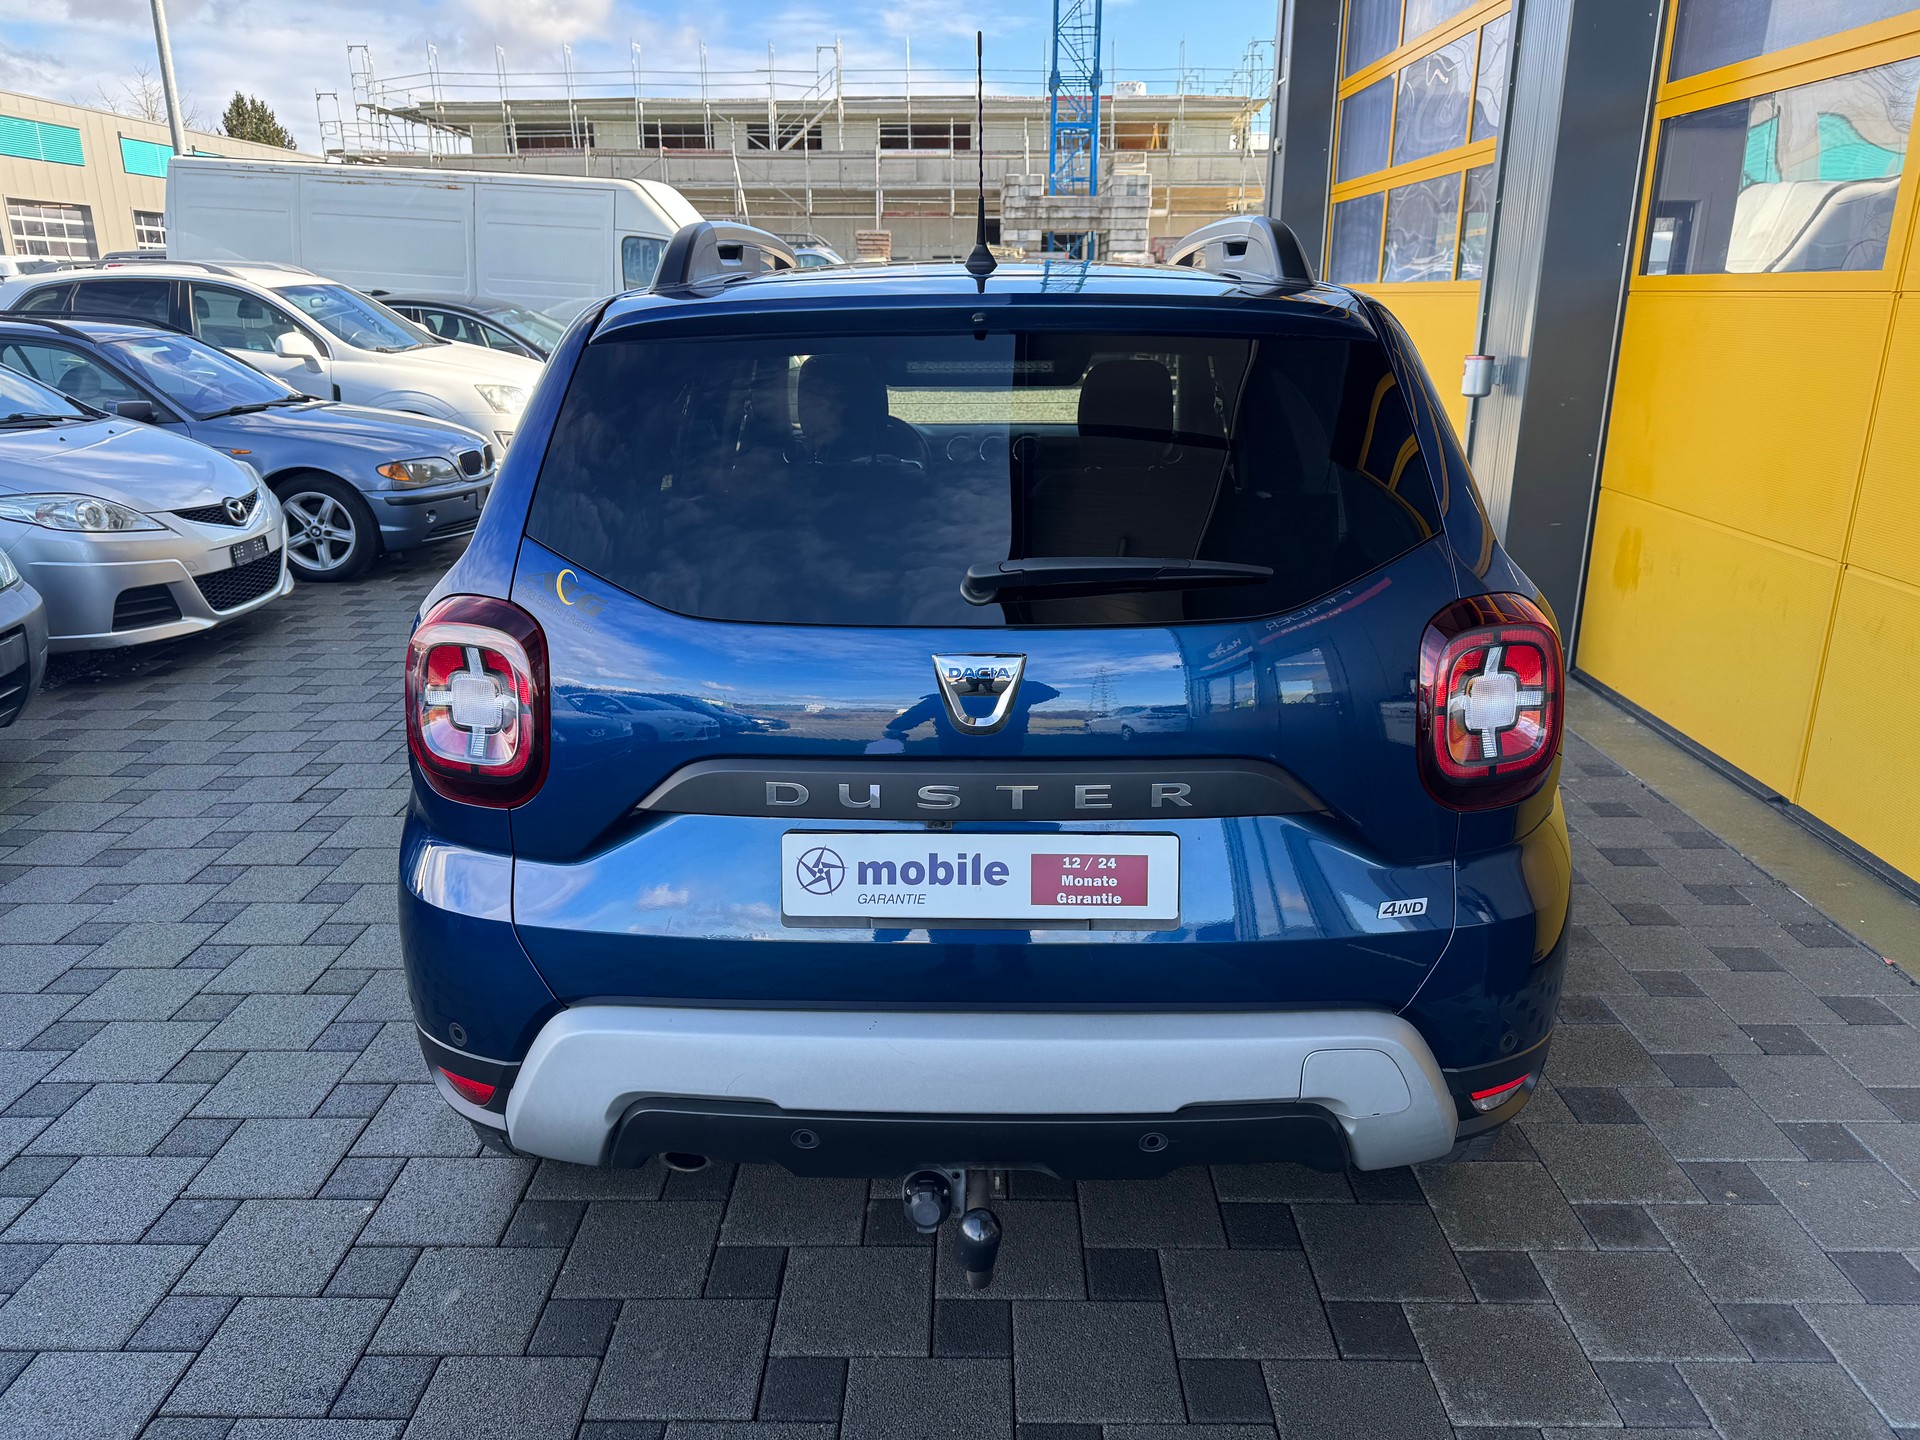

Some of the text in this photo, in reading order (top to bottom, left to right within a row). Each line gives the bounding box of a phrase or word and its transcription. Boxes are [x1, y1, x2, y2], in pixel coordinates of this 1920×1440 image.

[537, 593, 563, 616] Buchs
[568, 613, 595, 635] Aarau
[948, 667, 1011, 679] DACIA
[765, 781, 1193, 810] DUSTER
[857, 852, 1010, 886] mobile
[1063, 857, 1117, 871] 12 / 24
[1061, 874, 1118, 887] Monate
[857, 893, 927, 905] GARANTIE
[1056, 892, 1122, 904] Garantie
[1382, 901, 1424, 917] 4WD
